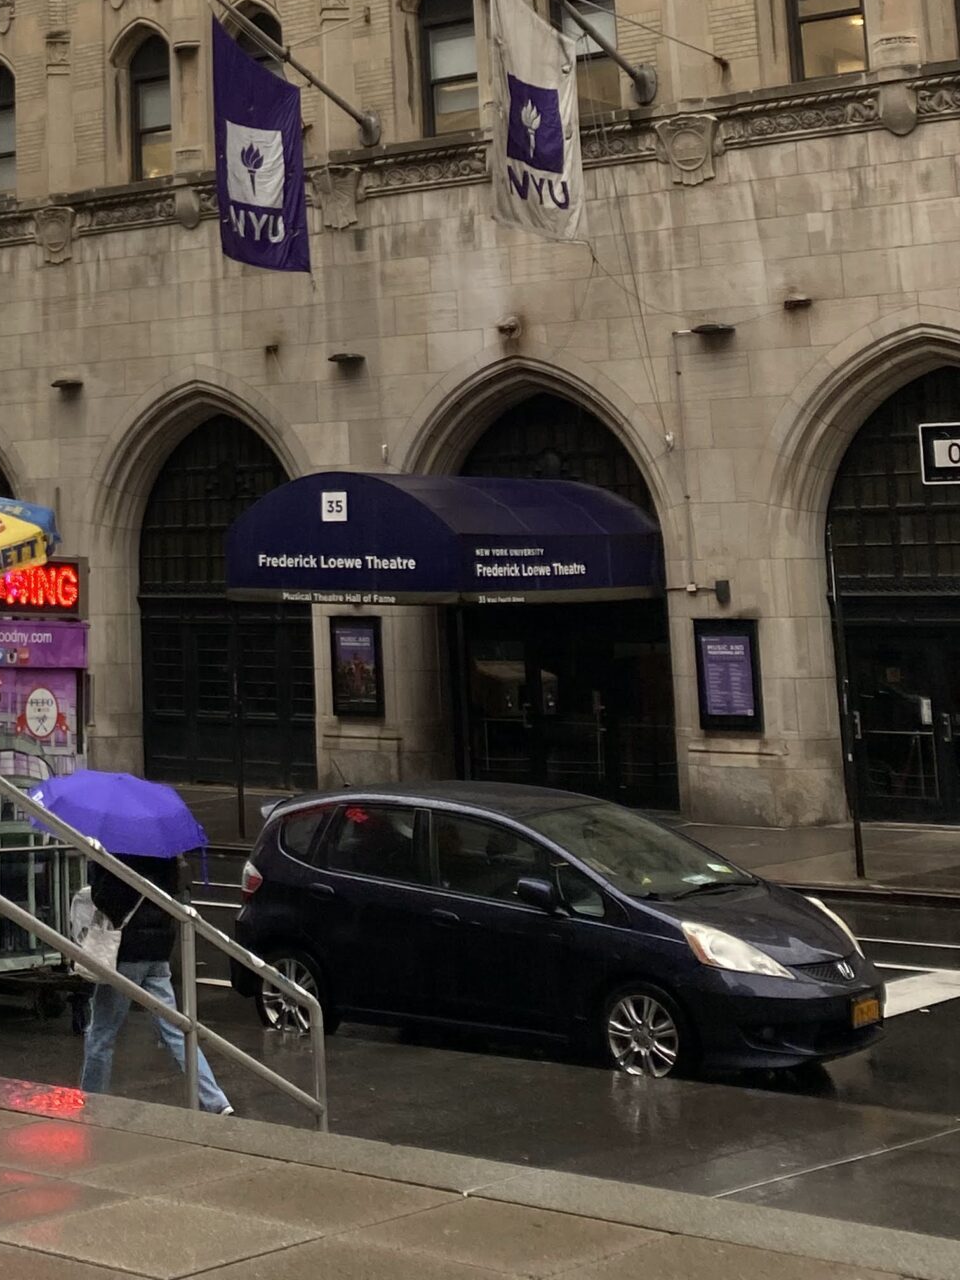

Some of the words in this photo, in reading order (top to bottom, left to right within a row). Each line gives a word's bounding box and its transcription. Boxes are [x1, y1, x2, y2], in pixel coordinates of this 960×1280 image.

[507, 165, 570, 210] NYU
[229, 205, 285, 244] NYU
[326, 500, 343, 514] 35
[475, 548, 490, 557] NEW
[491, 548, 509, 557] YORK
[509, 548, 545, 557] UNIVERSITY
[258, 554, 318, 569] Frederick
[320, 555, 363, 569] Loewe
[365, 555, 417, 570] Theatre
[476, 563, 521, 577] Frederick
[521, 563, 552, 577] Loewe
[552, 562, 586, 576] Theatre
[282, 591, 312, 601] Musical
[313, 592, 344, 602] Theatre
[345, 592, 362, 603] Hall
[363, 593, 372, 603] of
[373, 594, 396, 604] Fame
